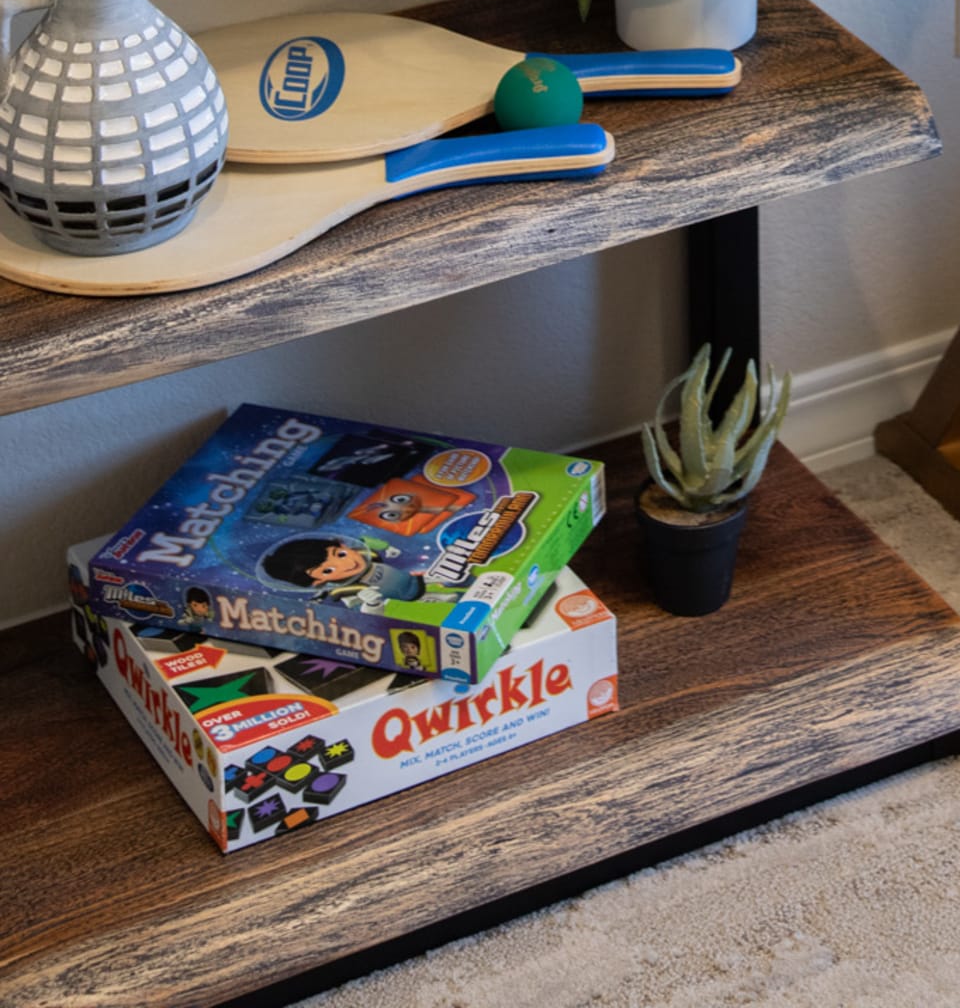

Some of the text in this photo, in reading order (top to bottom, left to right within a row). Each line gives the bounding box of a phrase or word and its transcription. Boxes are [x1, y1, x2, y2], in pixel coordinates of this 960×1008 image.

[274, 45, 313, 110] COOP
[136, 418, 323, 568] Matching
[216, 595, 386, 664] Matching
[165, 652, 204, 668] WOOD
[171, 658, 208, 674] TILES!
[335, 647, 361, 660] GAME
[113, 627, 194, 768] Qwirkle
[371, 658, 574, 759] Qwirkle
[202, 709, 243, 728] OVER
[209, 701, 305, 742] 3 MILLION
[268, 709, 311, 730] SOLD!
[464, 726, 500, 746] SCORE
[501, 716, 525, 734] AND
